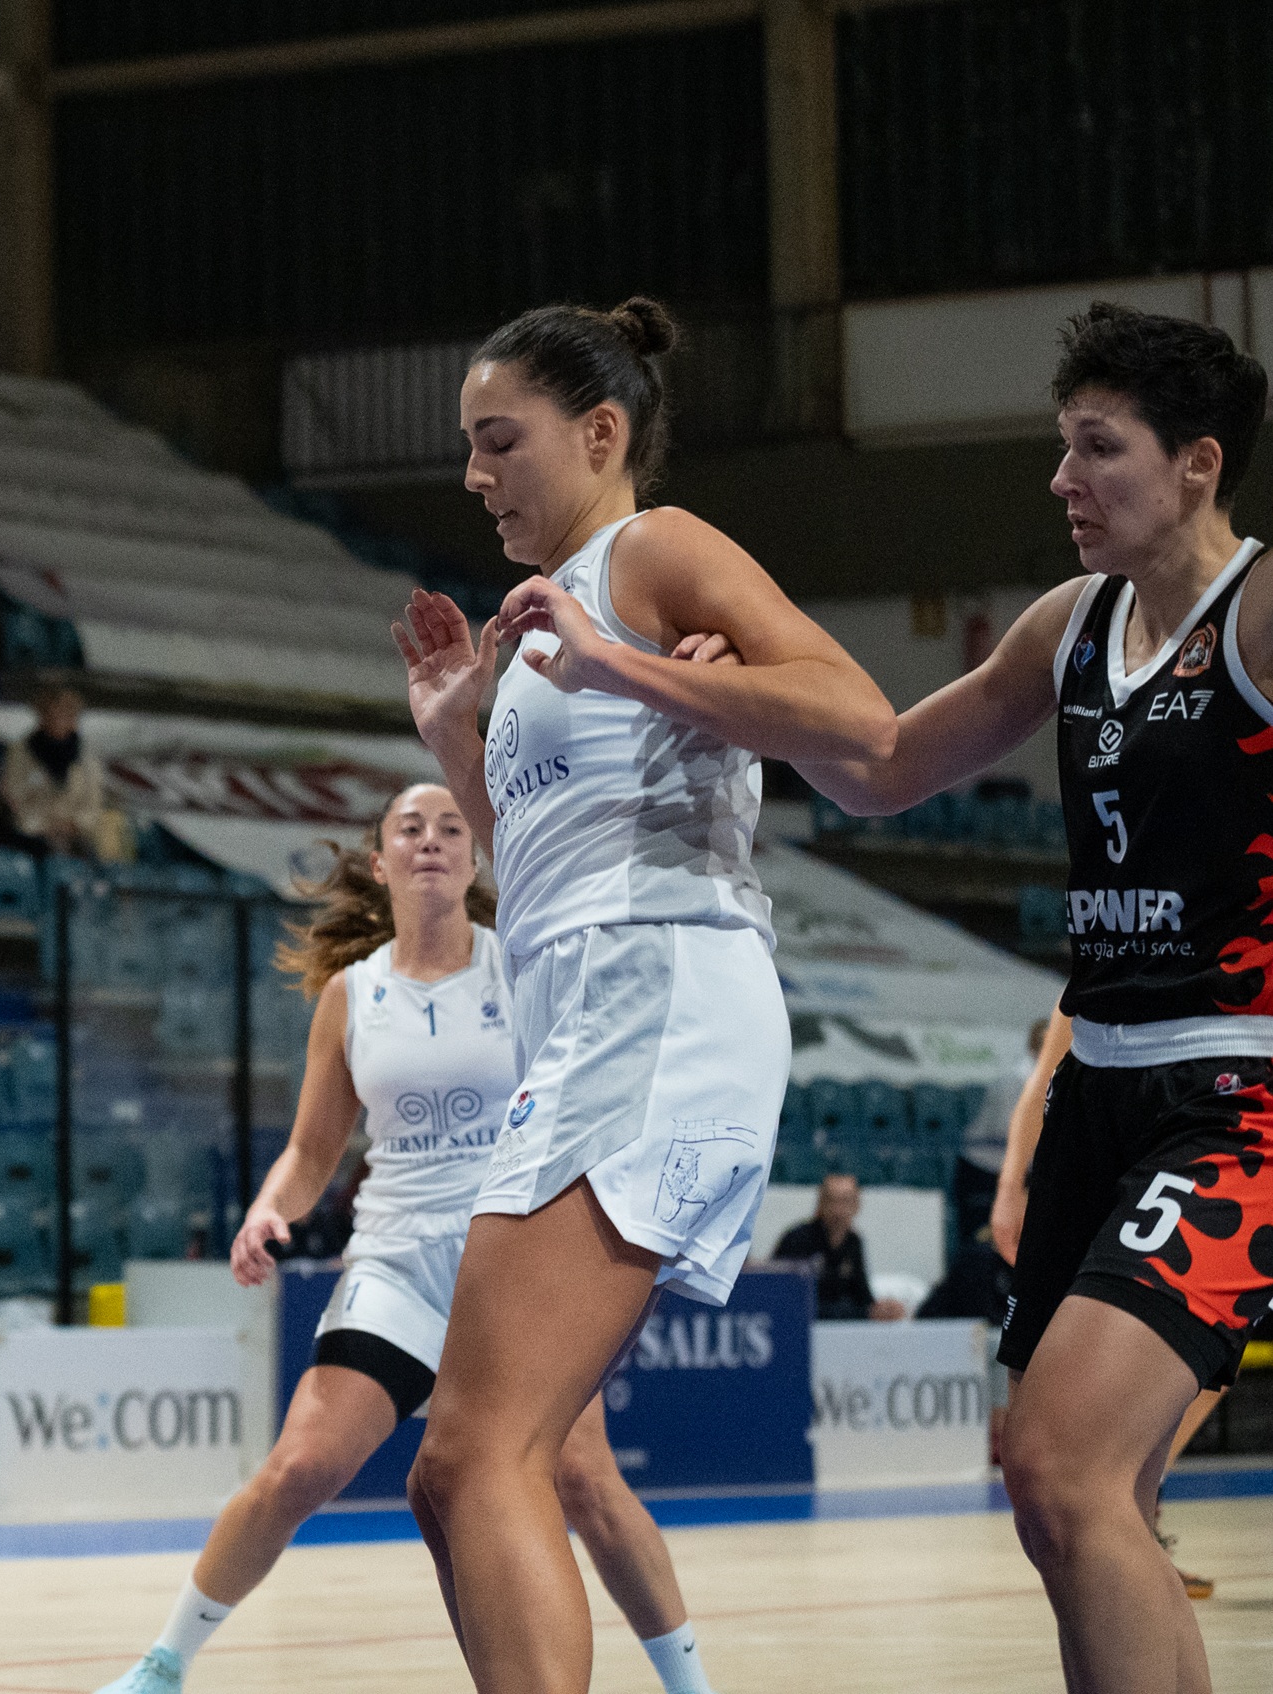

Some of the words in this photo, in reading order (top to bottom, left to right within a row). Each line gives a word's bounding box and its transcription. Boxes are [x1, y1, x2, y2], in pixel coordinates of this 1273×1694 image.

[1147, 690, 1214, 721] EA7
[1088, 752, 1121, 769] BITRE
[505, 755, 570, 807] SALUS
[1092, 789, 1128, 865] 5
[422, 1001, 436, 1037] 1
[1118, 1171, 1197, 1252] 5
[346, 1280, 361, 1312] 1
